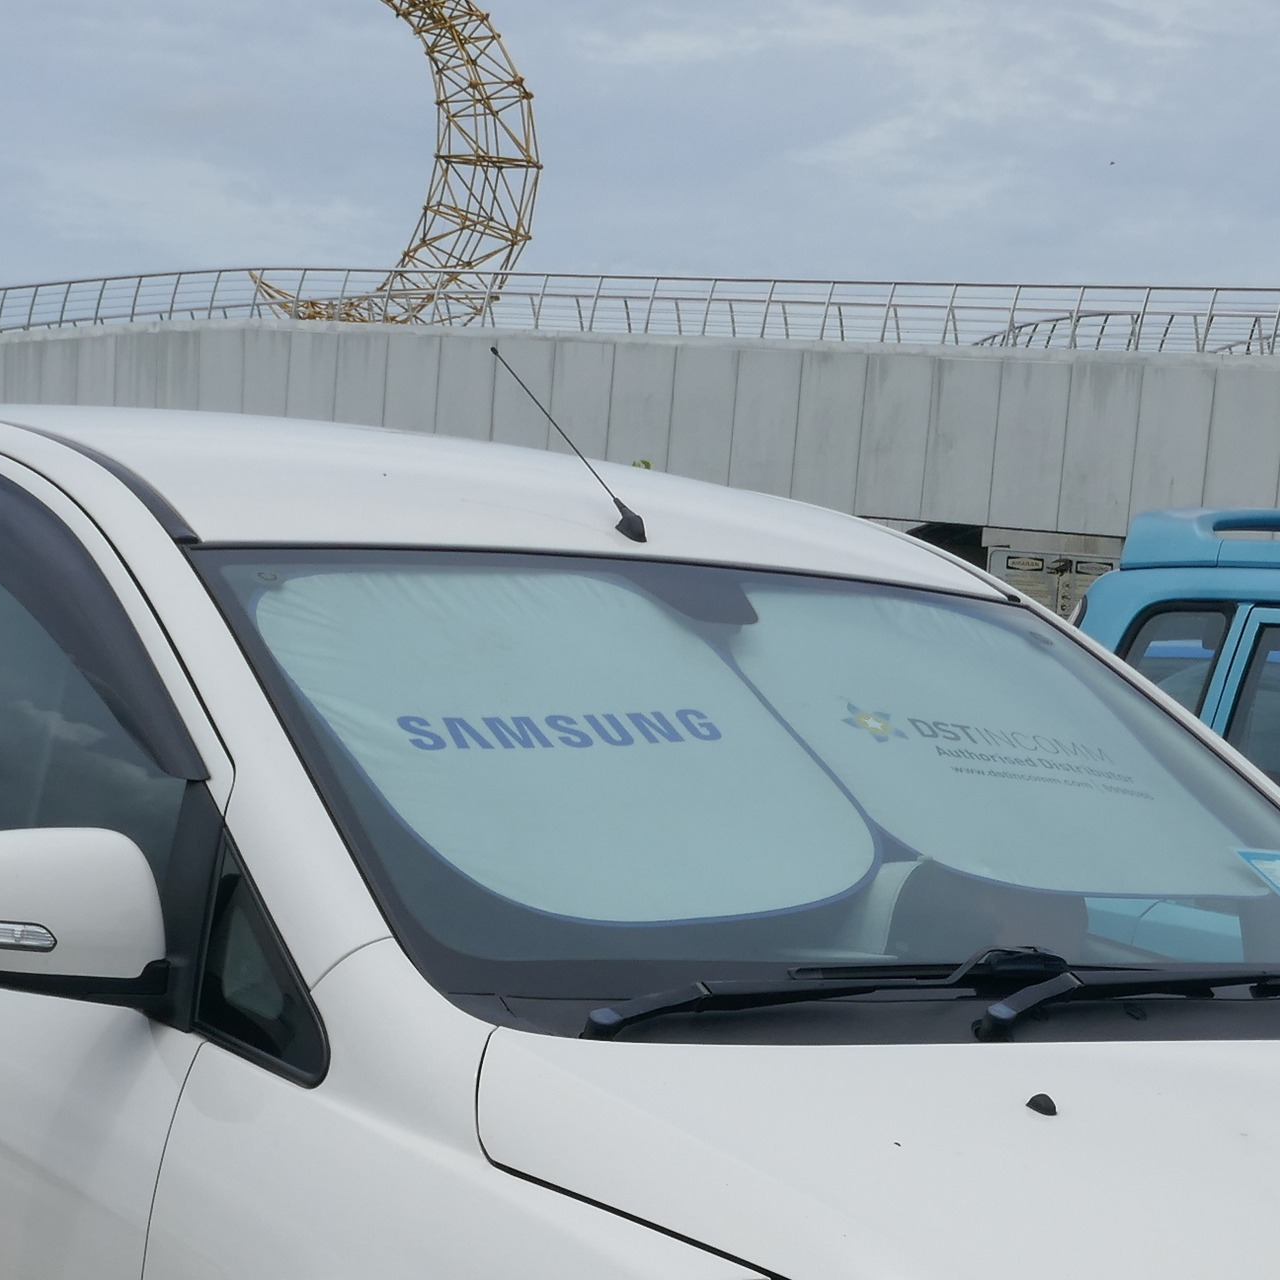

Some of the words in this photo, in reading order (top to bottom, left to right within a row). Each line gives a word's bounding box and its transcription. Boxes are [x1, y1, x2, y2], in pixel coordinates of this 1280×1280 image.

[396, 708, 723, 751] SAMSUNG
[906, 718, 1116, 766] DSTINCOMM
[935, 745, 1038, 768] Authorised
[1037, 757, 1134, 784] Distributor
